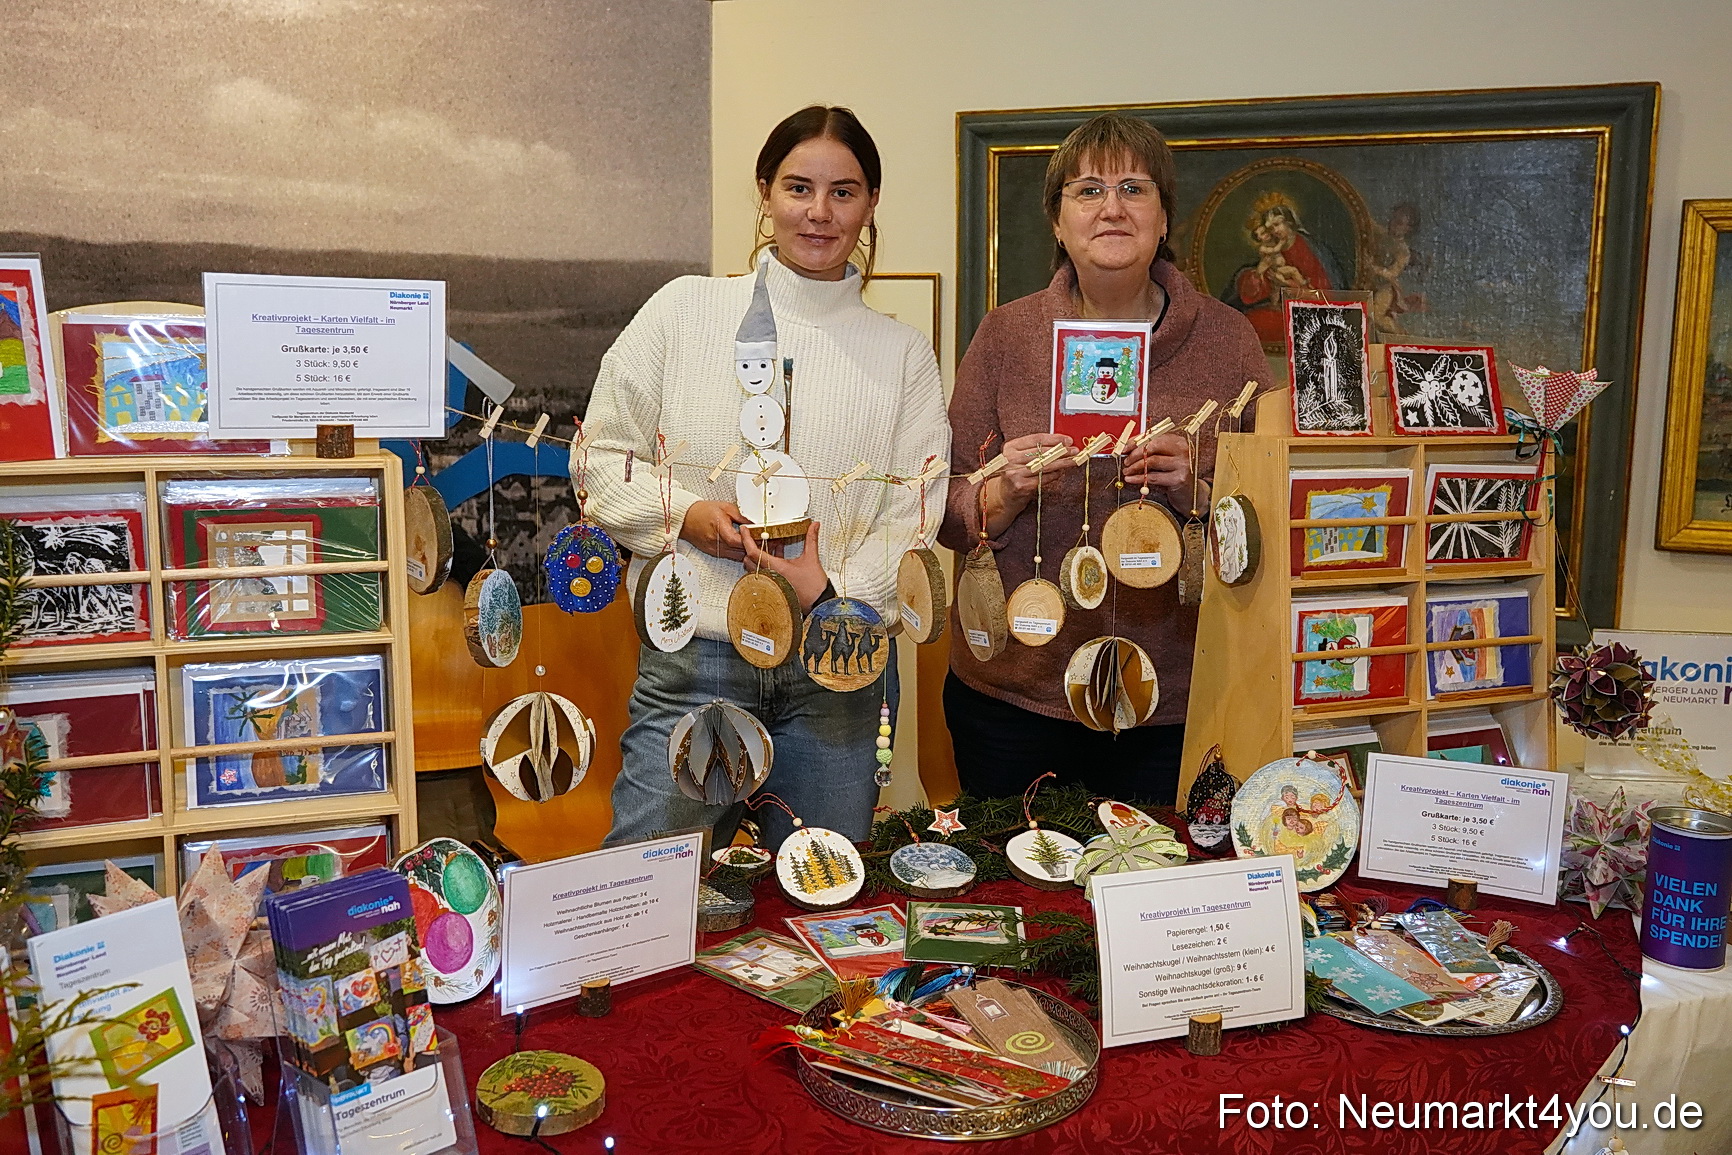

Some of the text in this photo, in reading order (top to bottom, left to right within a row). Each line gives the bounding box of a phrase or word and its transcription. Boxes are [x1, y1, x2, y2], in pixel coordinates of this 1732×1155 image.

[252, 313, 311, 323] Kreativprojekt
[321, 315, 348, 323] Karten
[350, 315, 379, 323] Vielfalt
[295, 325, 354, 334] Tageszentrum
[281, 345, 368, 355] Grußkarte: je 3,50 €
[295, 360, 301, 368] 3
[304, 359, 330, 368] Stück:
[333, 361, 351, 369] 9,50
[304, 374, 330, 382] Stück:
[1641, 656, 1732, 683] akoni
[1663, 696, 1717, 705] NEUMARKT
[1501, 778, 1541, 789] diakonie
[1401, 785, 1449, 796] Kreativprojekt
[1456, 791, 1479, 799] Karten
[1481, 794, 1505, 802] Vielfalt
[1434, 797, 1483, 809] Tageszentrum
[1422, 810, 1461, 822] Grußkarte:
[1463, 815, 1469, 823] je
[1472, 817, 1488, 825] 3,50
[1439, 824, 1461, 833] Stück:
[1462, 827, 1478, 835] 9,50
[1437, 836, 1459, 845] Stück:
[643, 845, 685, 859] diakonie
[675, 849, 694, 860] nah
[1247, 870, 1275, 880] Diakonie
[552, 885, 598, 900] Kreativprojekt
[609, 874, 653, 888] Tageszentrum
[1655, 872, 1718, 897] VIELEN
[347, 897, 389, 916] diakonie
[381, 901, 401, 914] nah
[557, 904, 593, 915] Weihnachtliche
[594, 899, 612, 908] Blumen
[623, 893, 639, 901] Papier:
[1653, 889, 1704, 913] DANK
[1140, 900, 1251, 920] Kreativprojekt im Tageszentrum
[543, 917, 572, 928] Holzmalerei
[1651, 907, 1727, 931] FÜR IHRE
[554, 920, 603, 935] Weihnachtsschmuck
[573, 925, 620, 940] Geschenkanhänger:
[1166, 922, 1231, 938] Papierengel: 1,50 €
[1649, 924, 1722, 949] SPENDE!
[1172, 939, 1215, 952] Lesezeichen:
[1223, 937, 1228, 945] €
[53, 945, 95, 963] Diakonie
[1123, 957, 1181, 972] Weihnachtskugel
[1186, 949, 1241, 964] Weihnachtsstern
[1242, 946, 1264, 958] (klein):
[1265, 945, 1270, 953] 4
[1270, 944, 1276, 953] €
[59, 968, 111, 989] Tageszentrum
[1155, 963, 1247, 983] Weihnachtskugel (groß): 9 €
[1138, 988, 1168, 999] Sonstige
[1170, 977, 1244, 994] Weihnachtsdekoration:
[1259, 974, 1264, 982] €
[335, 1088, 406, 1121] Tageszentrum
